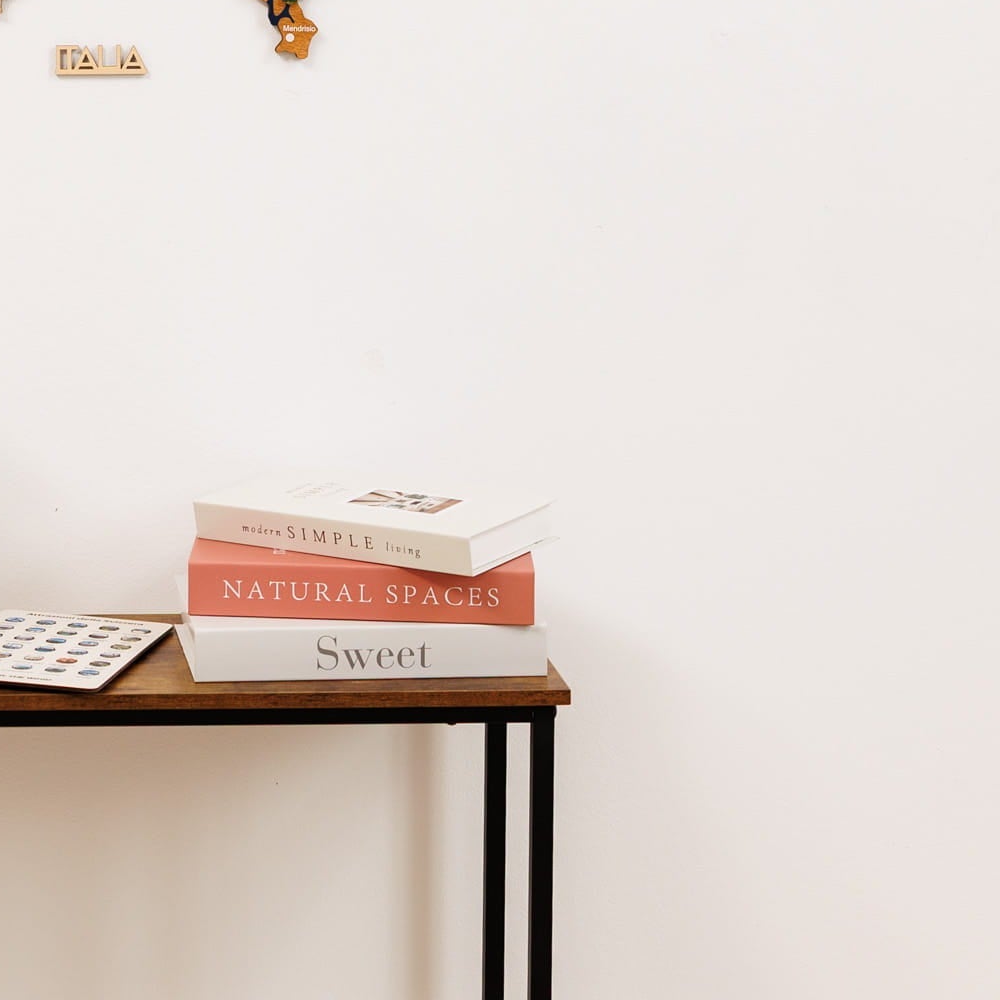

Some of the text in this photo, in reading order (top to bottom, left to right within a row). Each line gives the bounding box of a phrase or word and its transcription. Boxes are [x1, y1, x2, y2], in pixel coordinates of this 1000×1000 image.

[56, 44, 147, 73] ITALIA
[241, 522, 421, 559] modern SIMPLE living
[223, 579, 500, 607] NATURAL SPACES
[316, 634, 432, 672] Sweet
